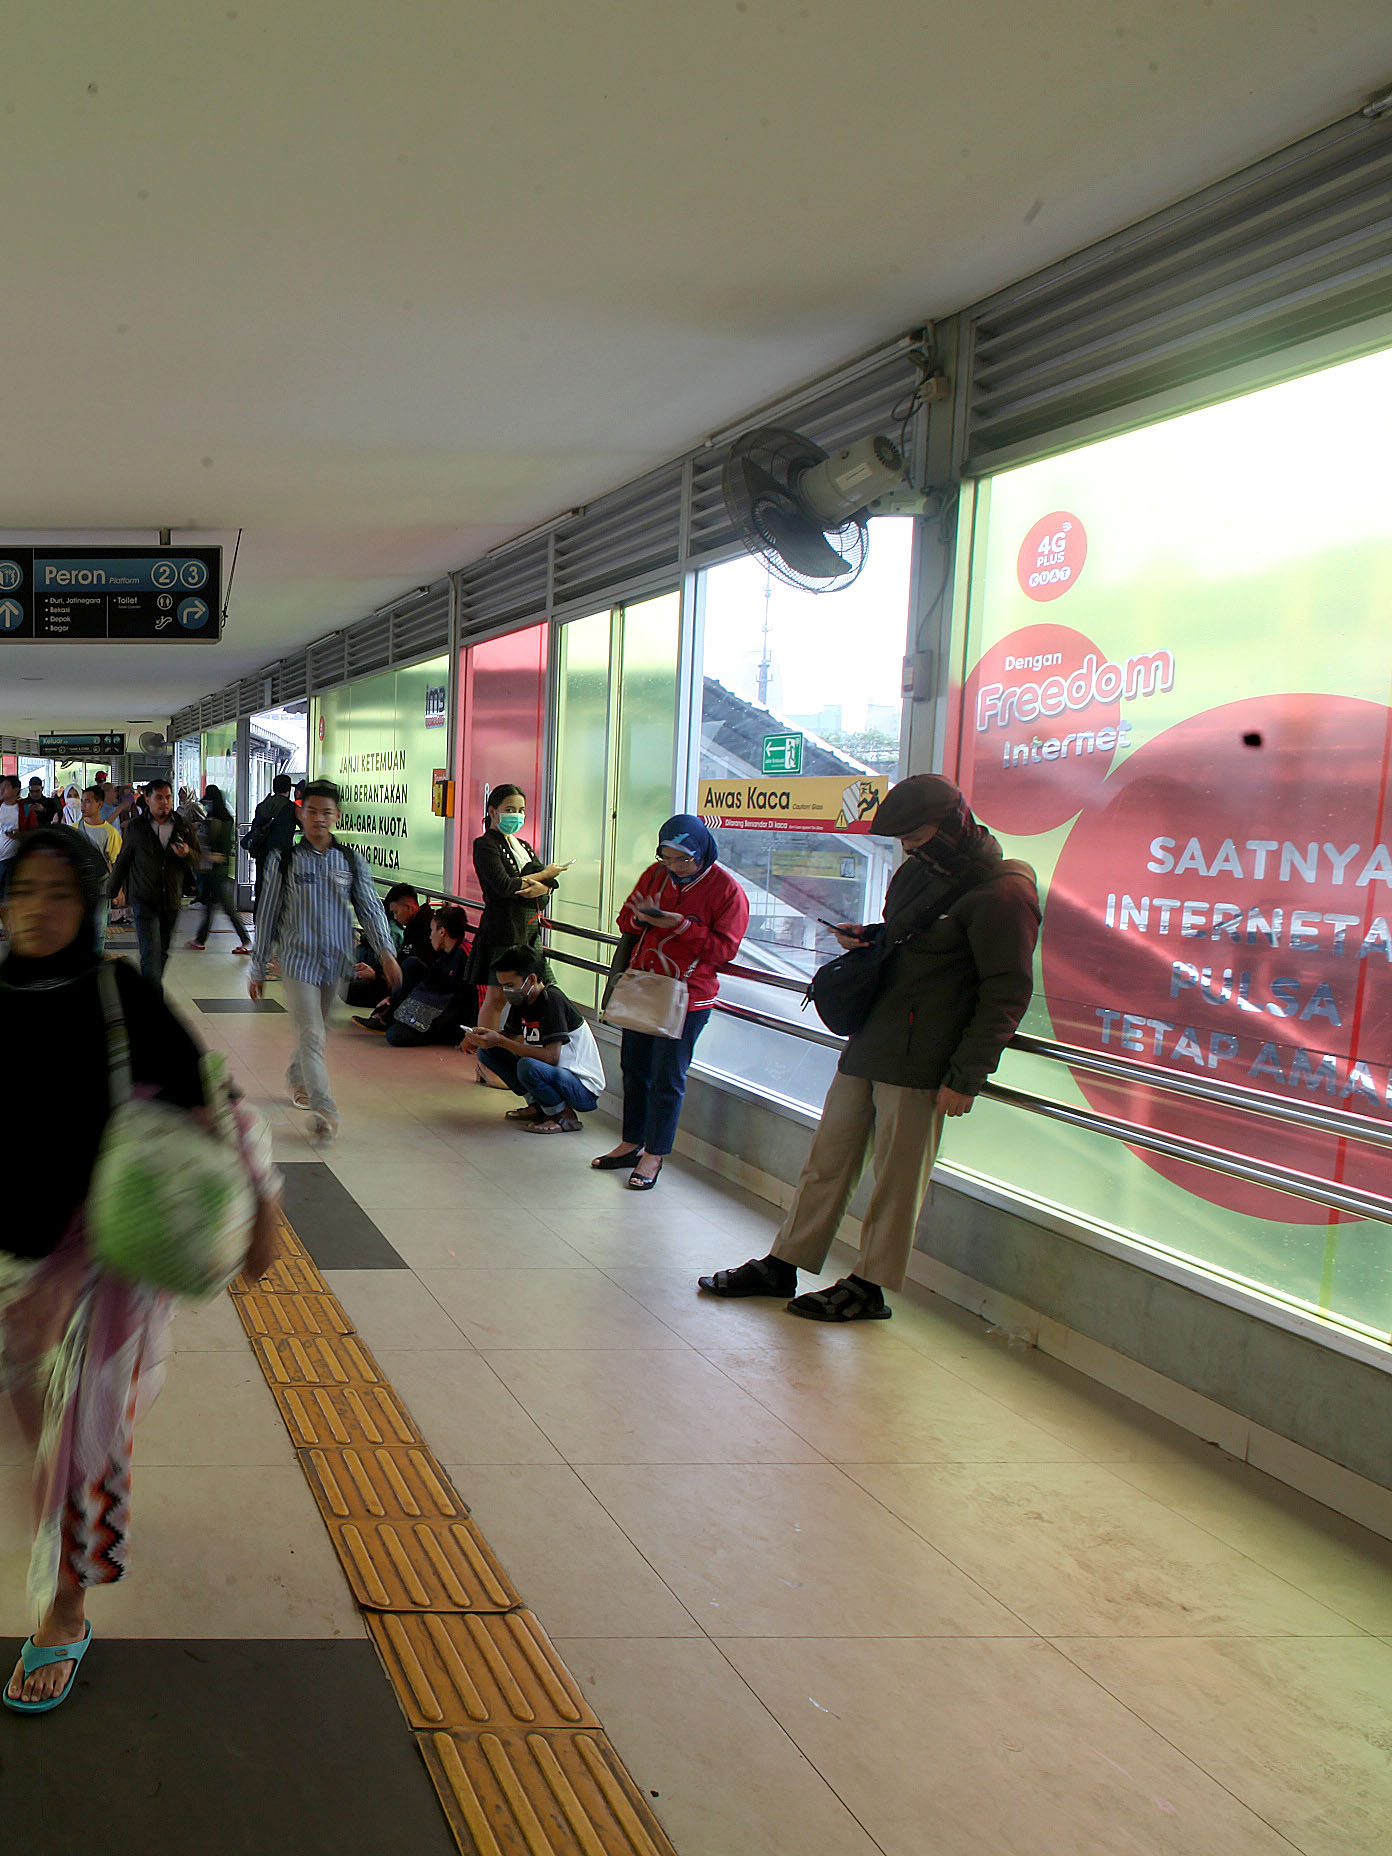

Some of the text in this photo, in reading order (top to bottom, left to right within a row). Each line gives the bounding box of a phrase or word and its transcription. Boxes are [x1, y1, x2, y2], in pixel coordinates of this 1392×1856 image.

[1037, 532, 1067, 556] 4G
[1036, 552, 1065, 568] PLUS
[45, 566, 106, 585] Peron
[158, 566, 170, 583] 2
[188, 566, 199, 584] 3
[1029, 566, 1072, 587] KUAT
[66, 597, 101, 605] Jatinegara
[1005, 652, 1063, 672] Dengan
[976, 648, 1176, 732] Freedom
[1003, 719, 1133, 769] Internet
[339, 750, 406, 774] JANJI KETEMUAN
[354, 784, 408, 803] BERANTAKAN
[704, 787, 742, 809] Awas
[747, 787, 790, 809] Kaca
[336, 814, 408, 838] GARA-GARA KUOTA
[725, 819, 744, 828] Dilarang
[373, 846, 400, 870] PULSA
[1147, 836, 1392, 888] SAATNYA
[1170, 961, 1342, 1027] PULSA
[1096, 1008, 1392, 1109] TETAP AMA
